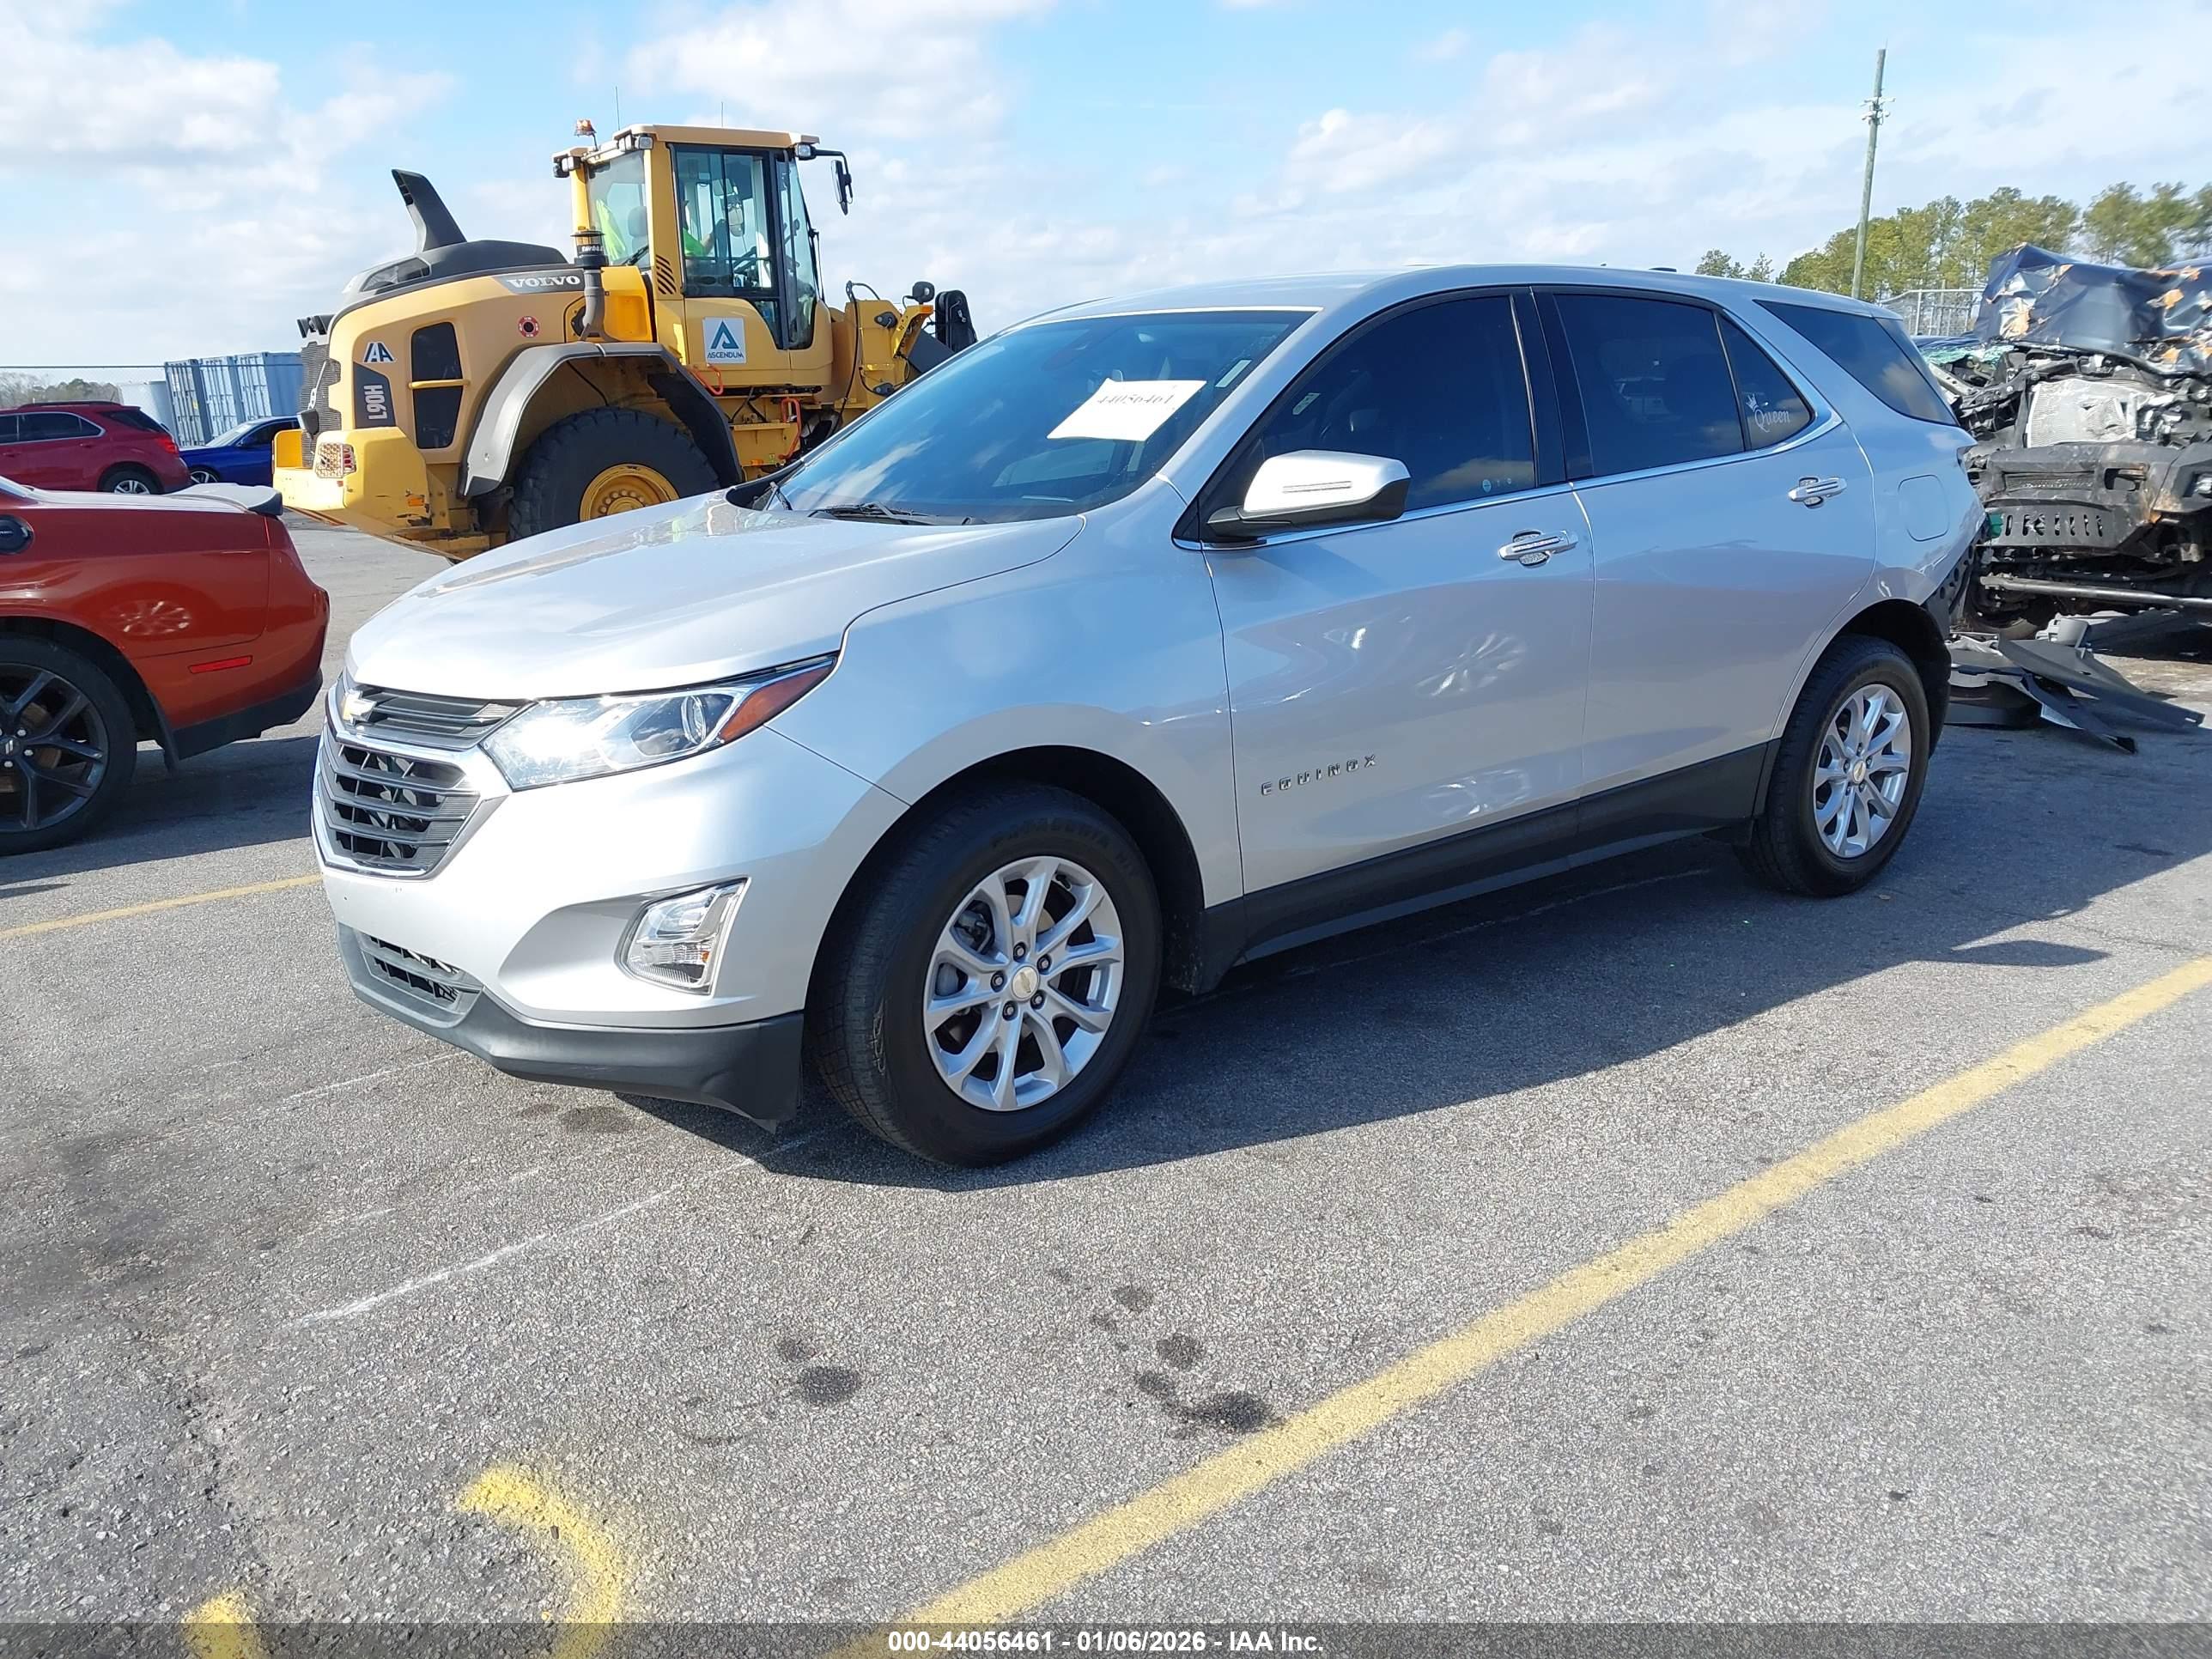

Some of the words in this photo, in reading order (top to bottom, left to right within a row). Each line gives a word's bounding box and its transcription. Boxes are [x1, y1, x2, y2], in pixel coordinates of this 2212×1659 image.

[507, 276, 580, 289] VOLVO
[363, 384, 388, 420] L90H
[1754, 409, 1790, 433] Queen
[1261, 754, 1376, 796] EQUINOX
